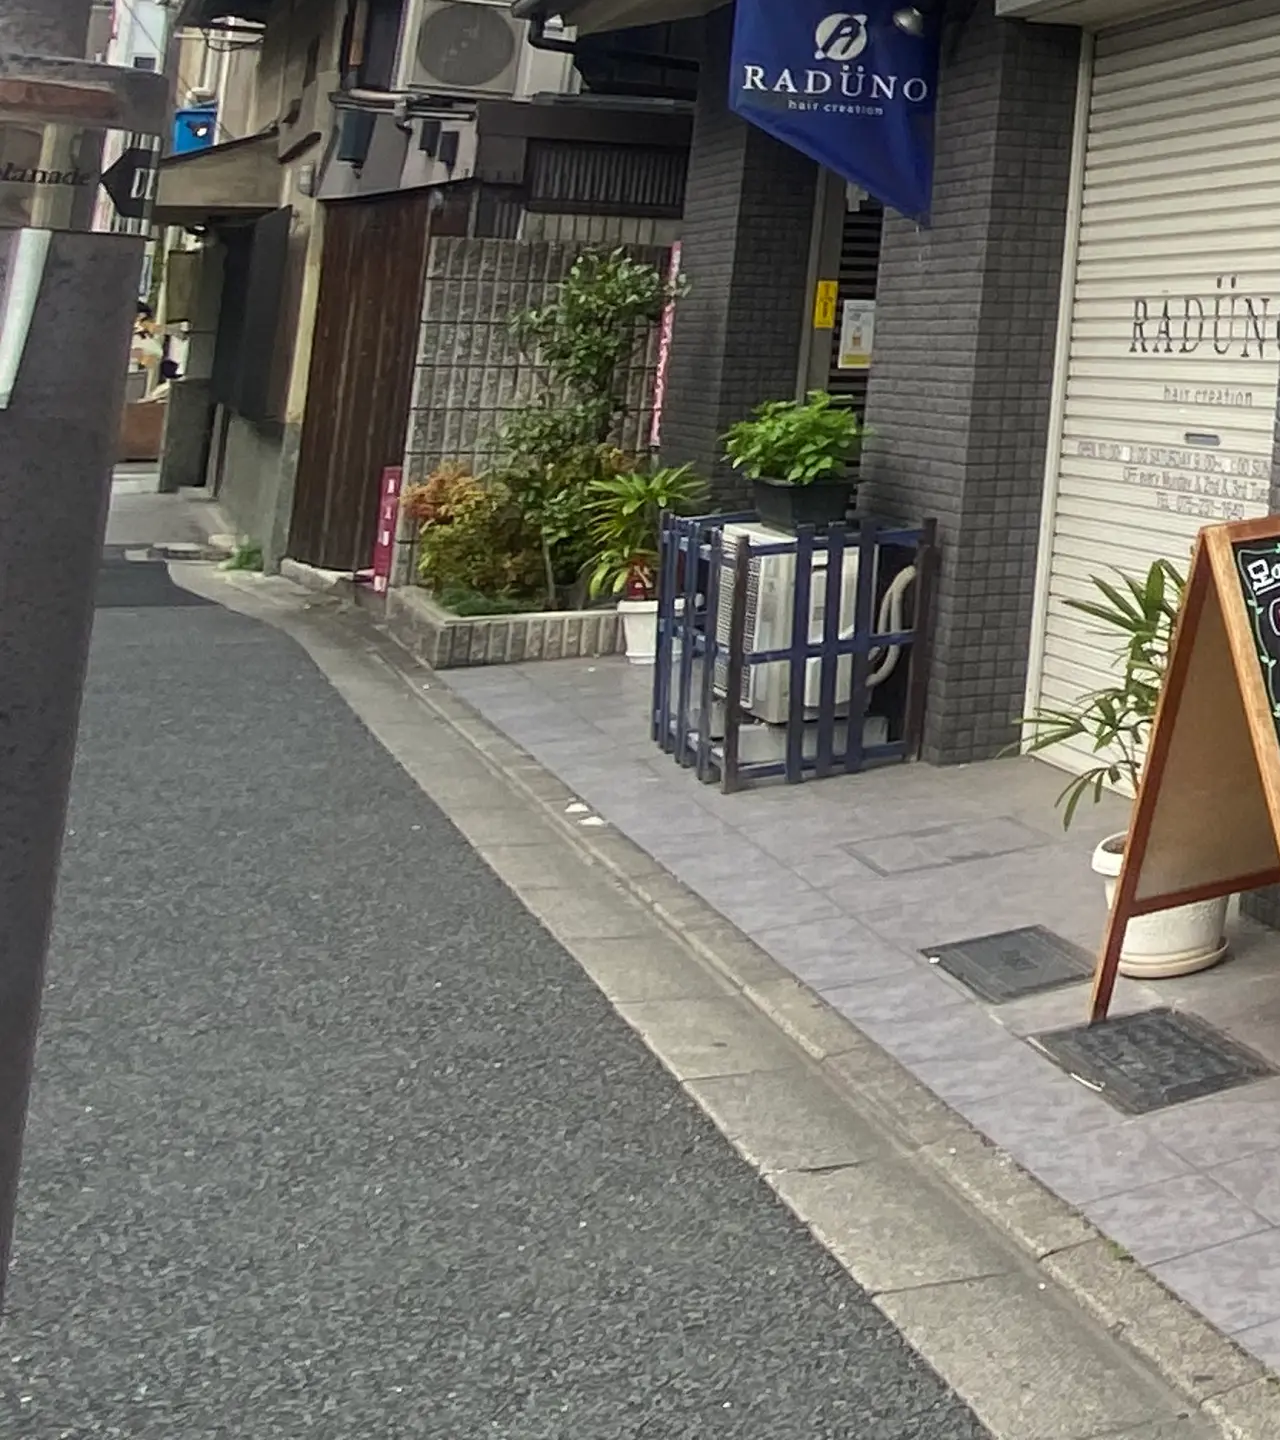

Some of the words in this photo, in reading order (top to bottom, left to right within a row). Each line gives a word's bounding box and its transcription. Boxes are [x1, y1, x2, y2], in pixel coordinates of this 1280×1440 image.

[743, 65, 928, 102] RADÜNO
[788, 98, 819, 111] hair
[823, 103, 884, 116] creation
[1163, 385, 1189, 402] hair
[1194, 388, 1252, 406] creation
